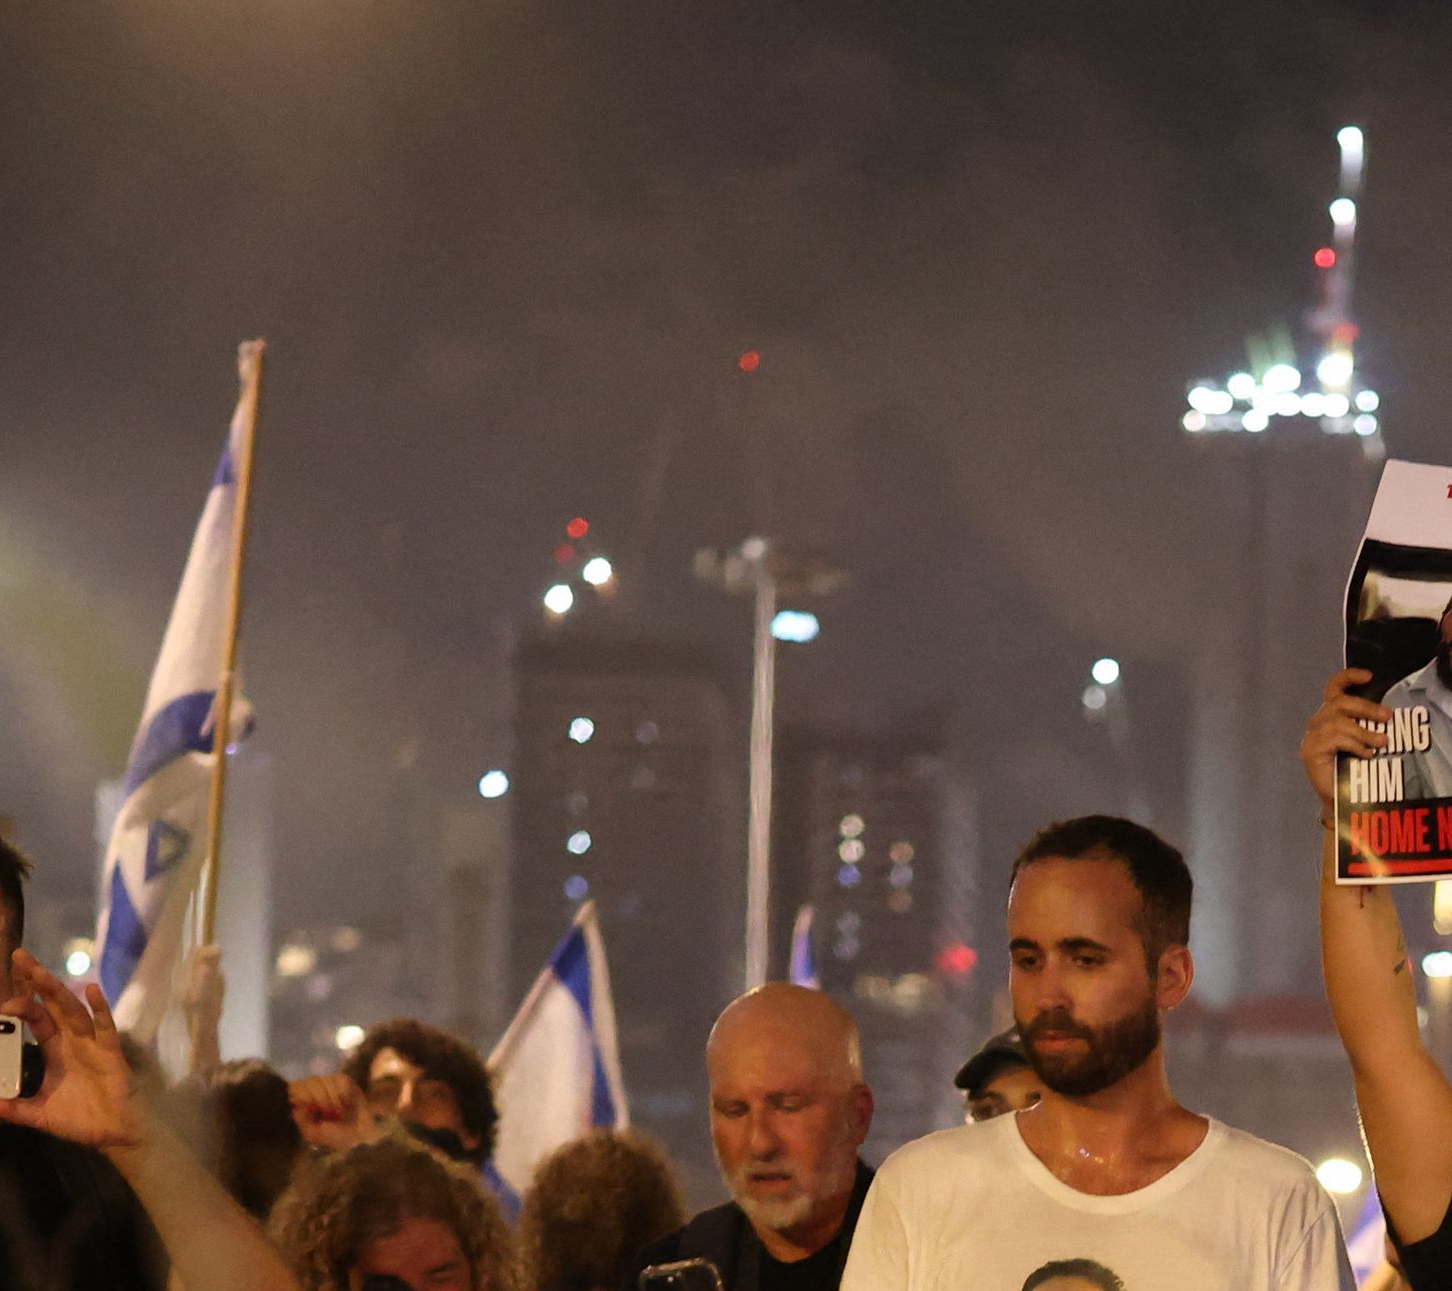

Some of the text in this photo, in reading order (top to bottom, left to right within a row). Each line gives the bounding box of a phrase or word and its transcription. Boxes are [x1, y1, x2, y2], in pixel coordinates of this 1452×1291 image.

[1355, 705, 1431, 754] ING
[1349, 756, 1405, 803] HIM
[1350, 808, 1432, 856] HOME
